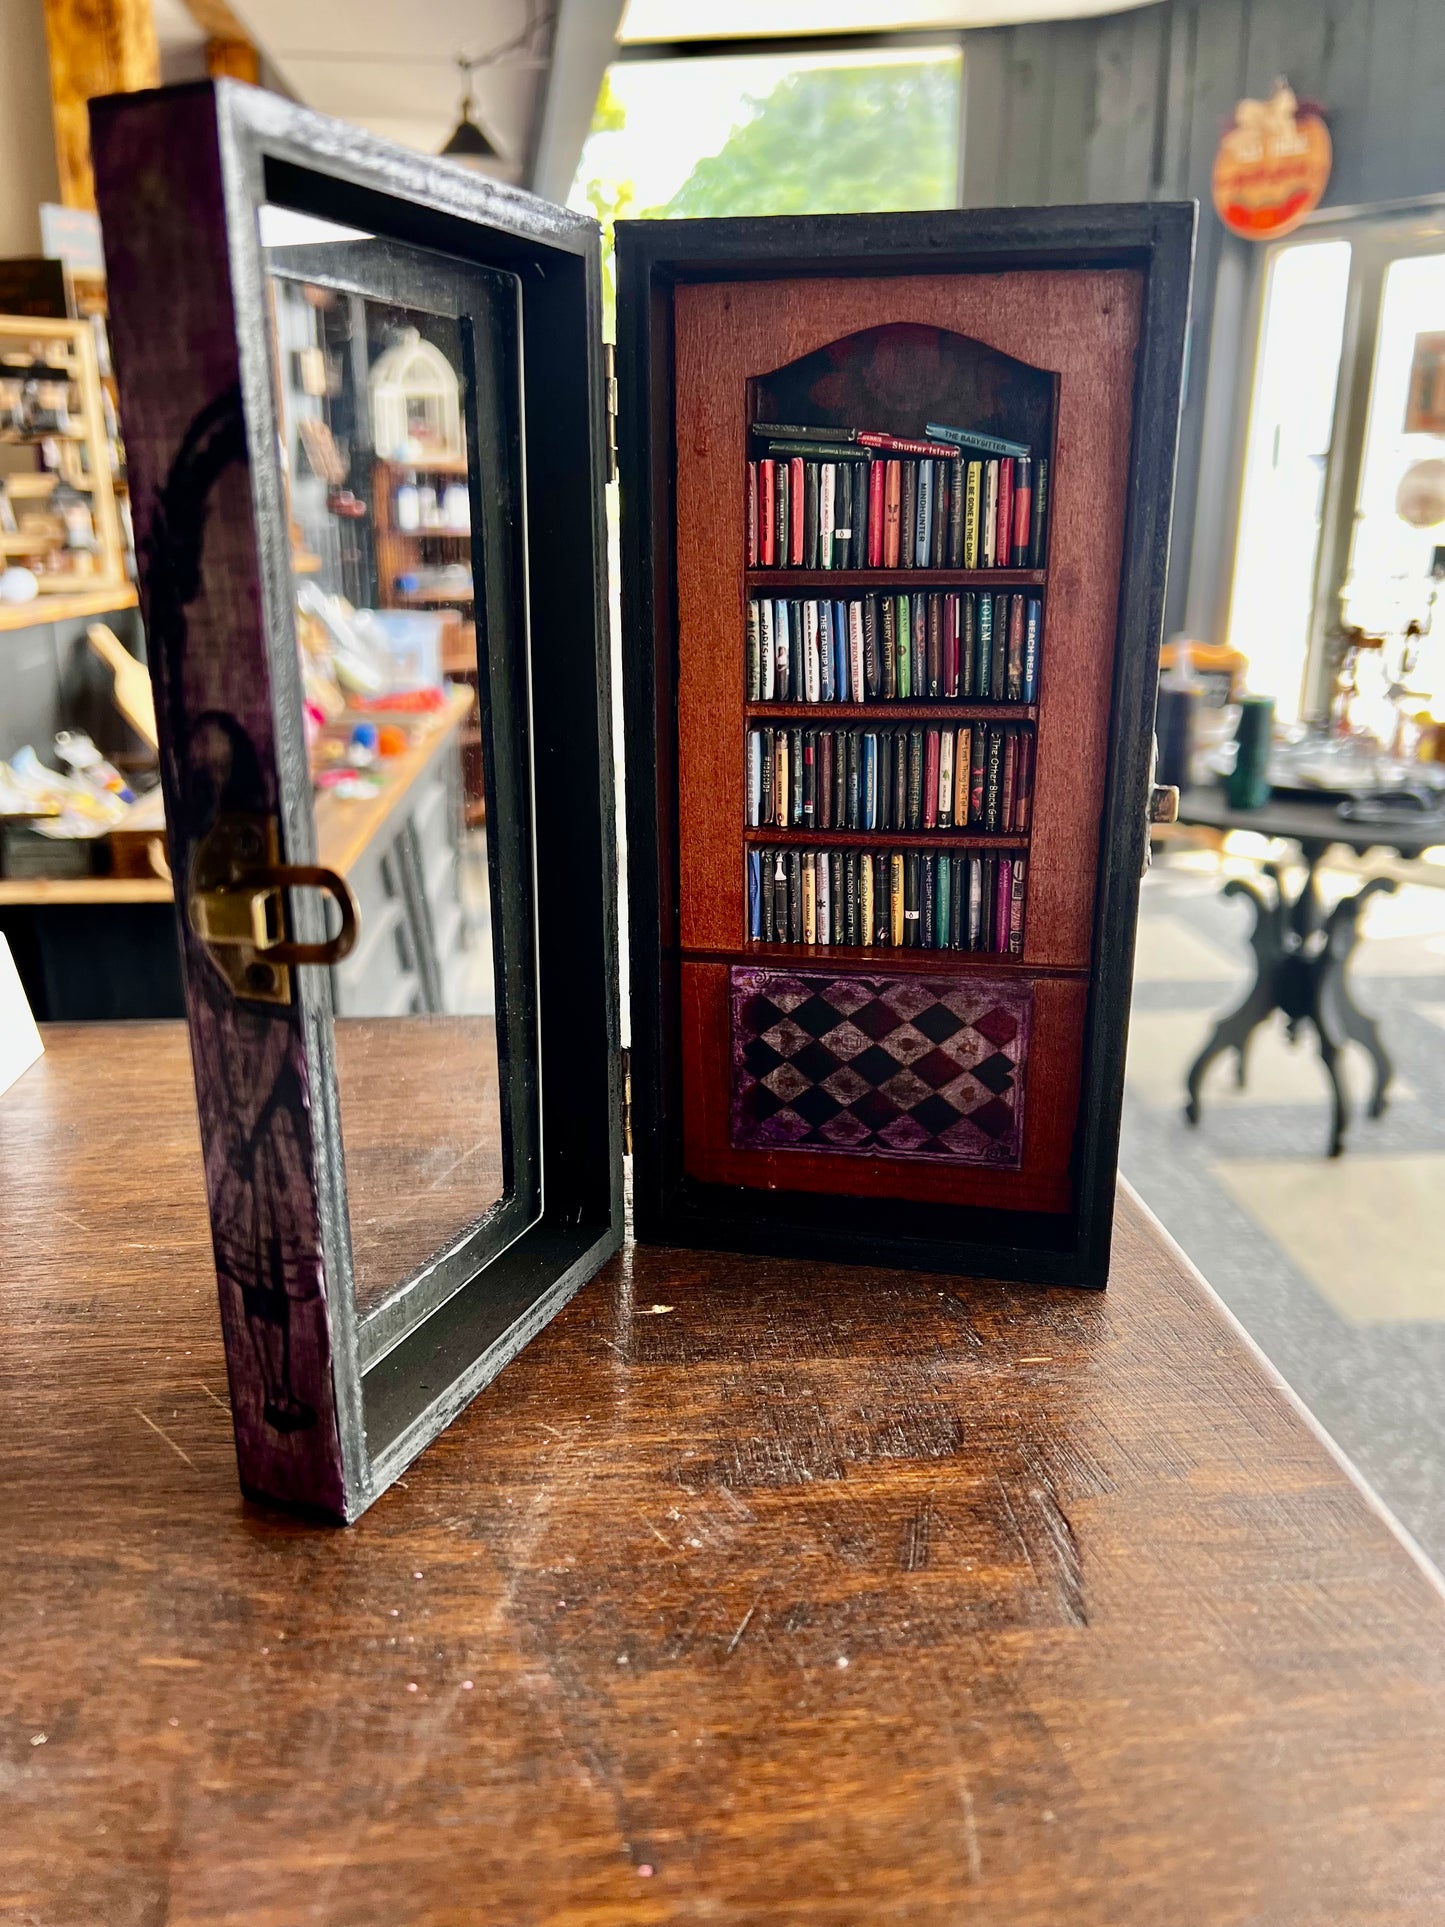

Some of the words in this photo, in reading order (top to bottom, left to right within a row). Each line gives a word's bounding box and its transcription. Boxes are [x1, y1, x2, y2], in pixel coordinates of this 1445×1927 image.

[892, 441, 928, 454] Shutter
[928, 446, 958, 458] Island
[944, 430, 961, 440] THE
[960, 433, 1008, 452] BABYSITTER
[969, 486, 975, 495] BE
[918, 482, 928, 543] MINDHUNTER
[967, 518, 974, 526] IN
[864, 613, 872, 650] ADNAN'S
[883, 613, 892, 640] HARRY
[1028, 619, 1036, 653] BEACH
[865, 652, 874, 680] STORY
[884, 642, 892, 670] POTTER
[1026, 656, 1034, 682] READ
[992, 738, 1000, 756] The
[959, 764, 968, 782] Thing
[990, 758, 1000, 784] Other
[962, 784, 968, 794] He
[988, 785, 998, 808] Black
[988, 808, 996, 824] Girl
